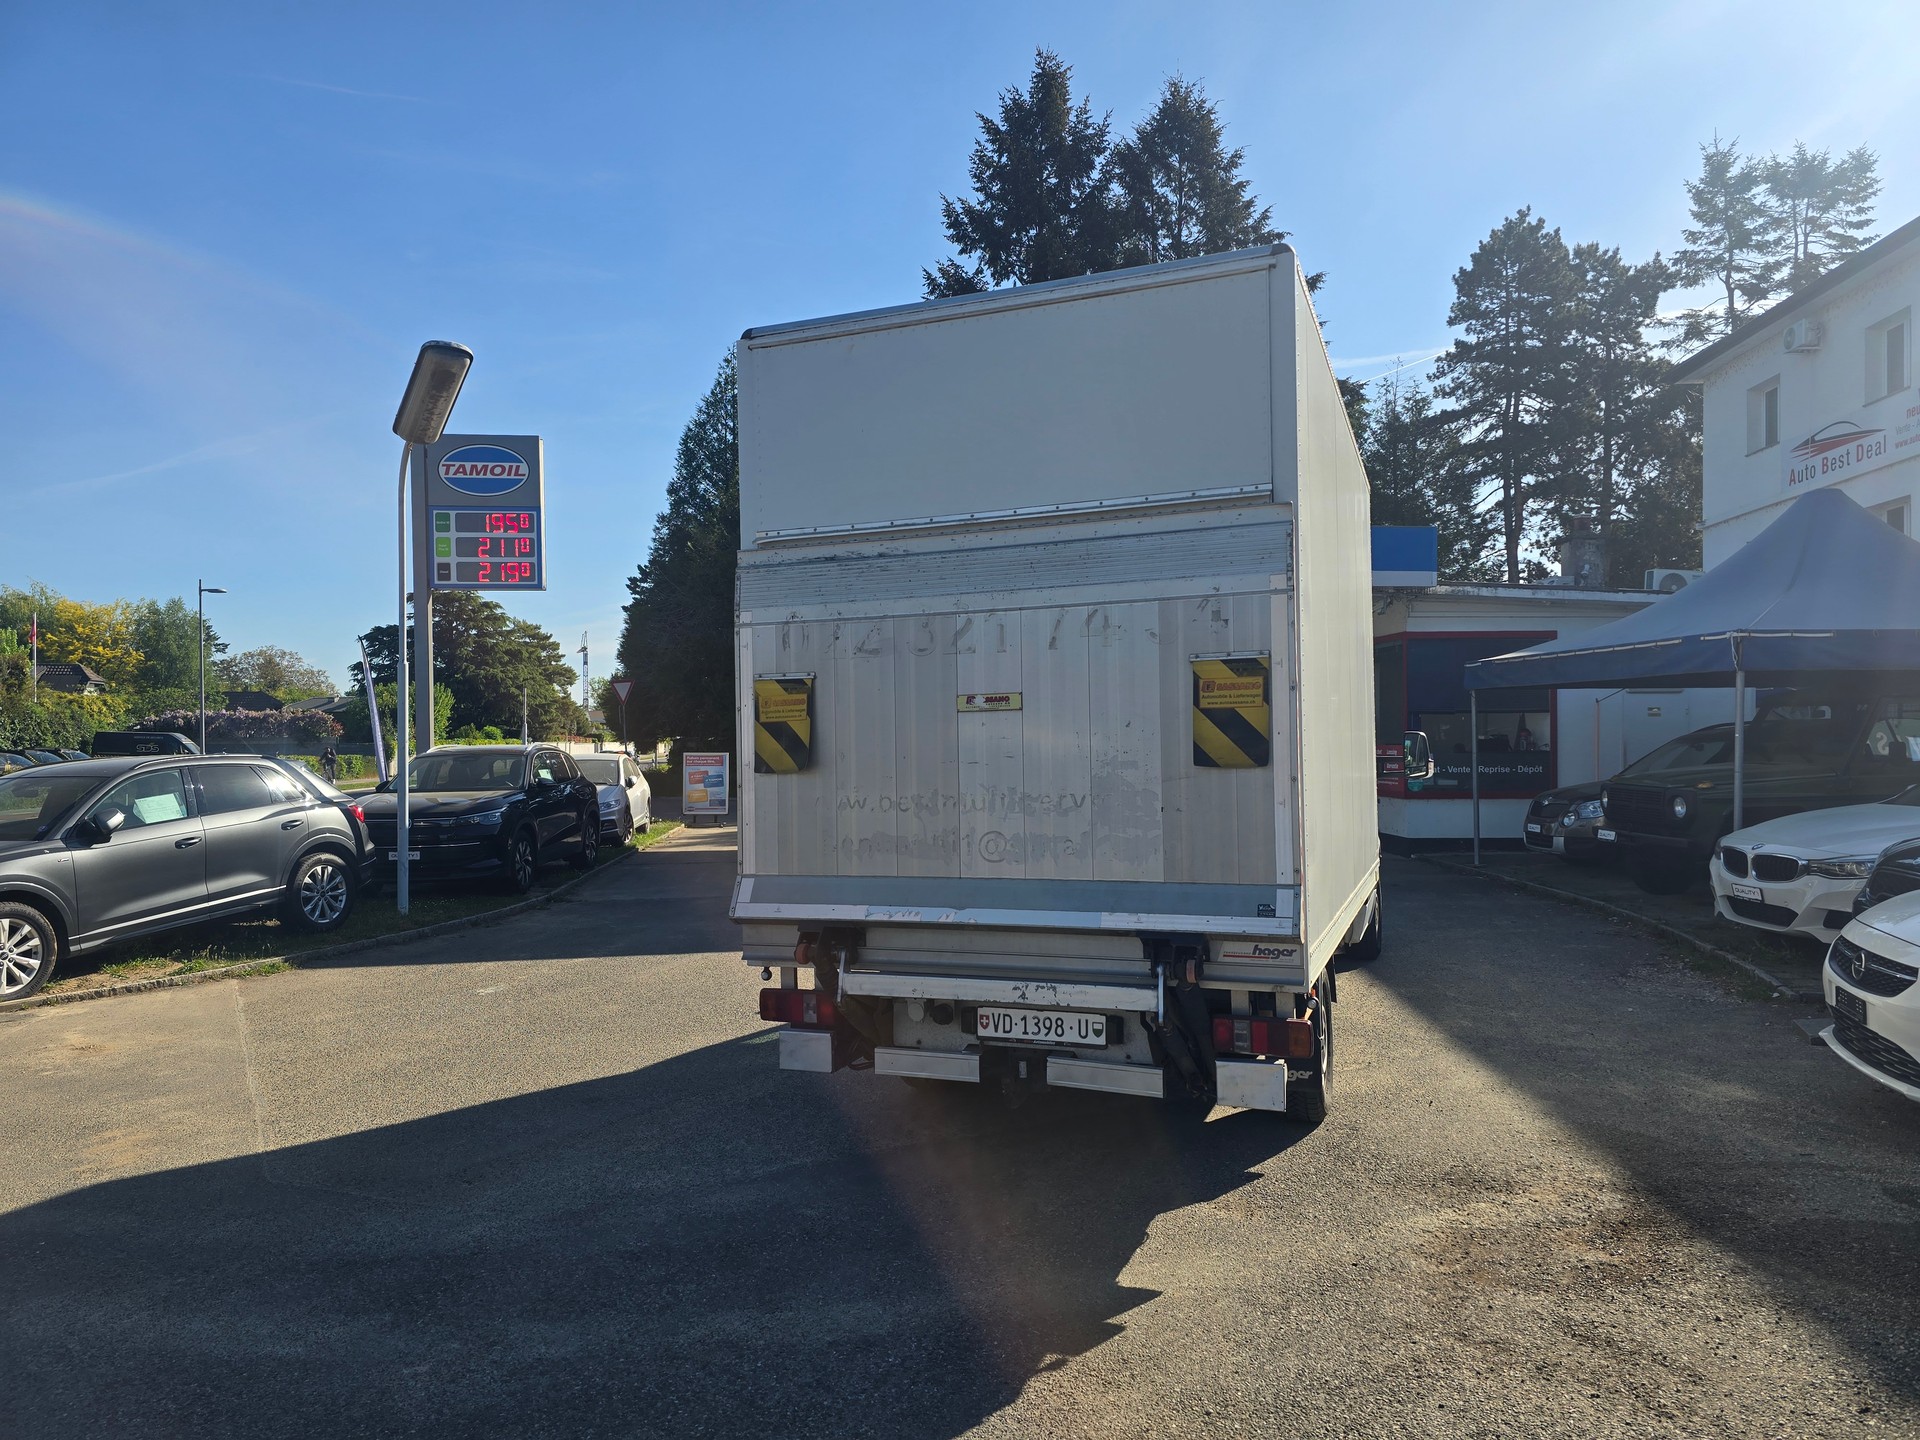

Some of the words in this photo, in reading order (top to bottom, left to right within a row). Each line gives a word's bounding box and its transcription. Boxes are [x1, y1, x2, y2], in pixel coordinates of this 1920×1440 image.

[1788, 464, 1817, 487] Auto
[1821, 448, 1851, 475] Best
[1856, 434, 1887, 463] Deal
[441, 463, 526, 477] TAMOIL
[1447, 765, 1471, 773] Vente
[1478, 765, 1510, 776] Reprise
[1517, 763, 1543, 775] Dépôt
[1252, 944, 1297, 959] hager
